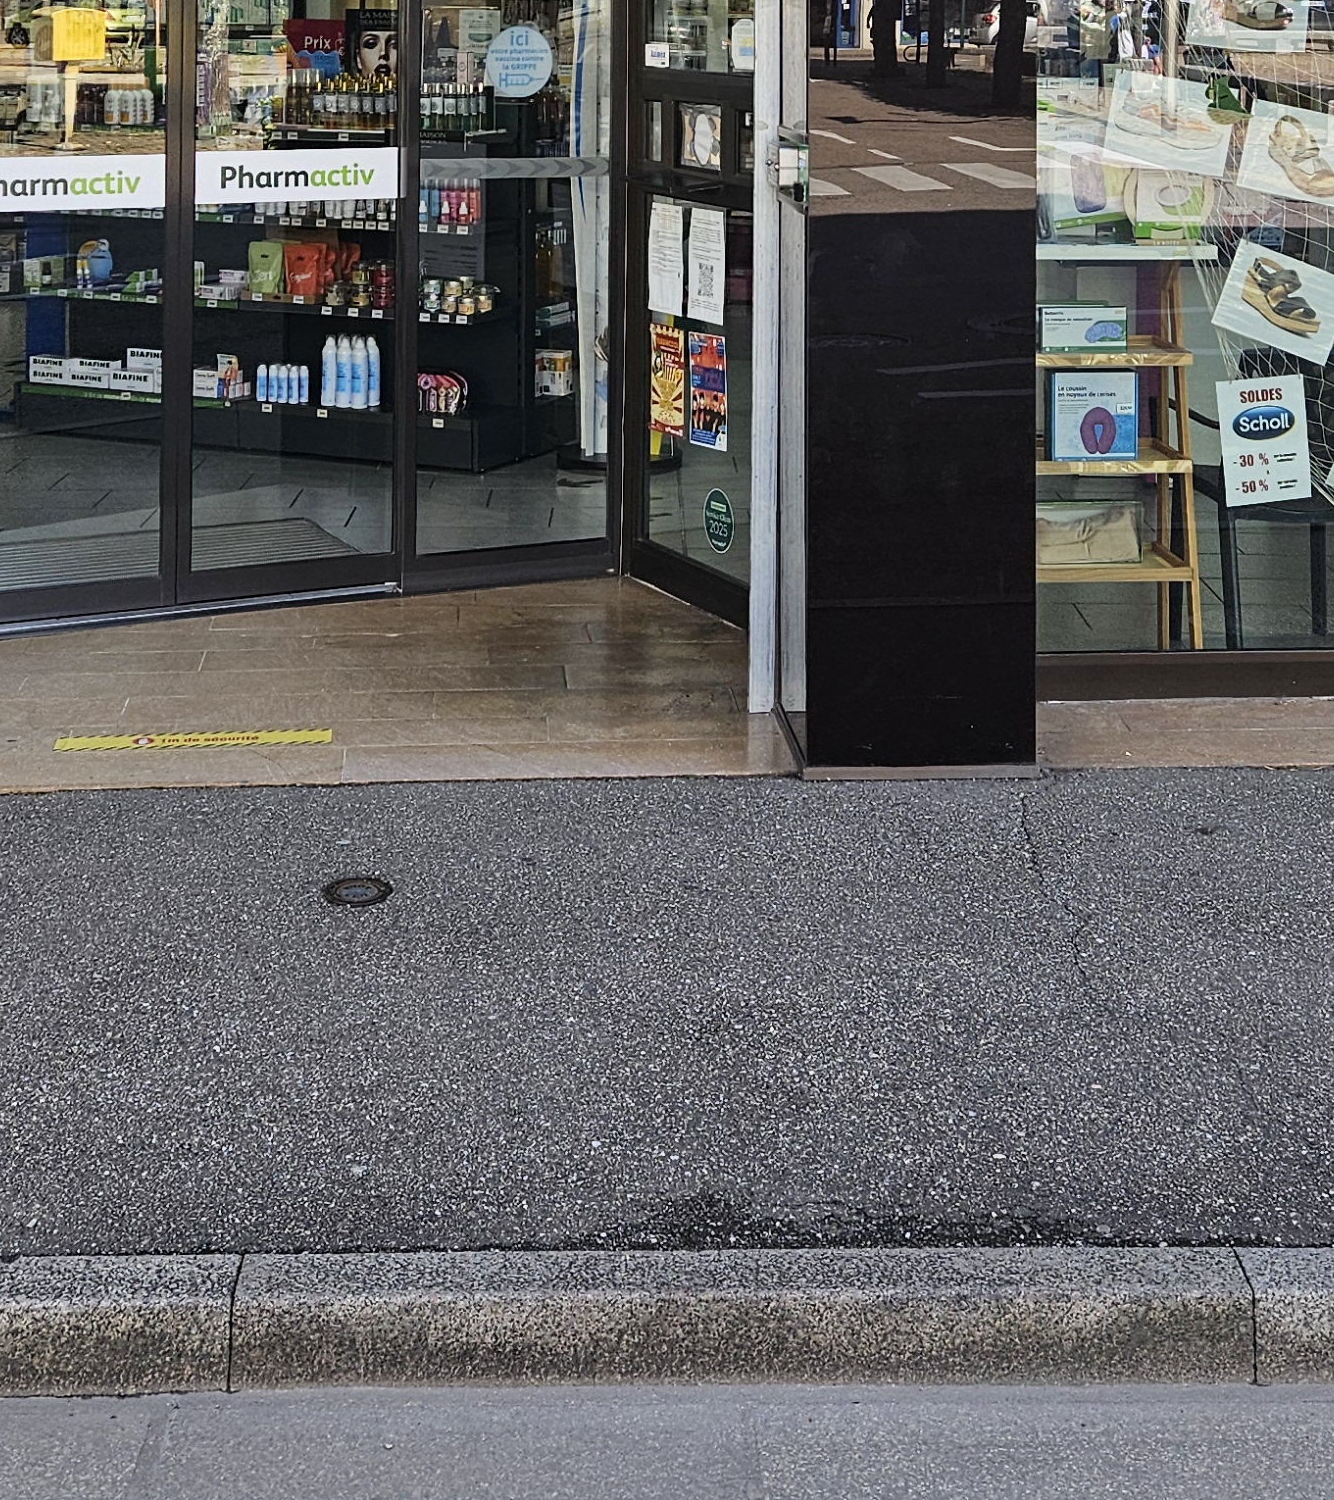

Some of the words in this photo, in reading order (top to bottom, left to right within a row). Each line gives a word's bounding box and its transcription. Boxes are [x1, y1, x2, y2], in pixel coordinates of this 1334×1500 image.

[304, 35, 332, 49] Prix
[510, 30, 529, 46] ici
[219, 163, 375, 190] Pharmactiv
[130, 350, 162, 359] BIAFIN
[33, 371, 63, 379] BIAFINE
[71, 374, 102, 382] BIAFINE
[113, 373, 148, 382] BIAFINE
[1240, 388, 1283, 403] SOLDES
[1239, 412, 1290, 432] Scholl
[709, 519, 728, 537] 2025
